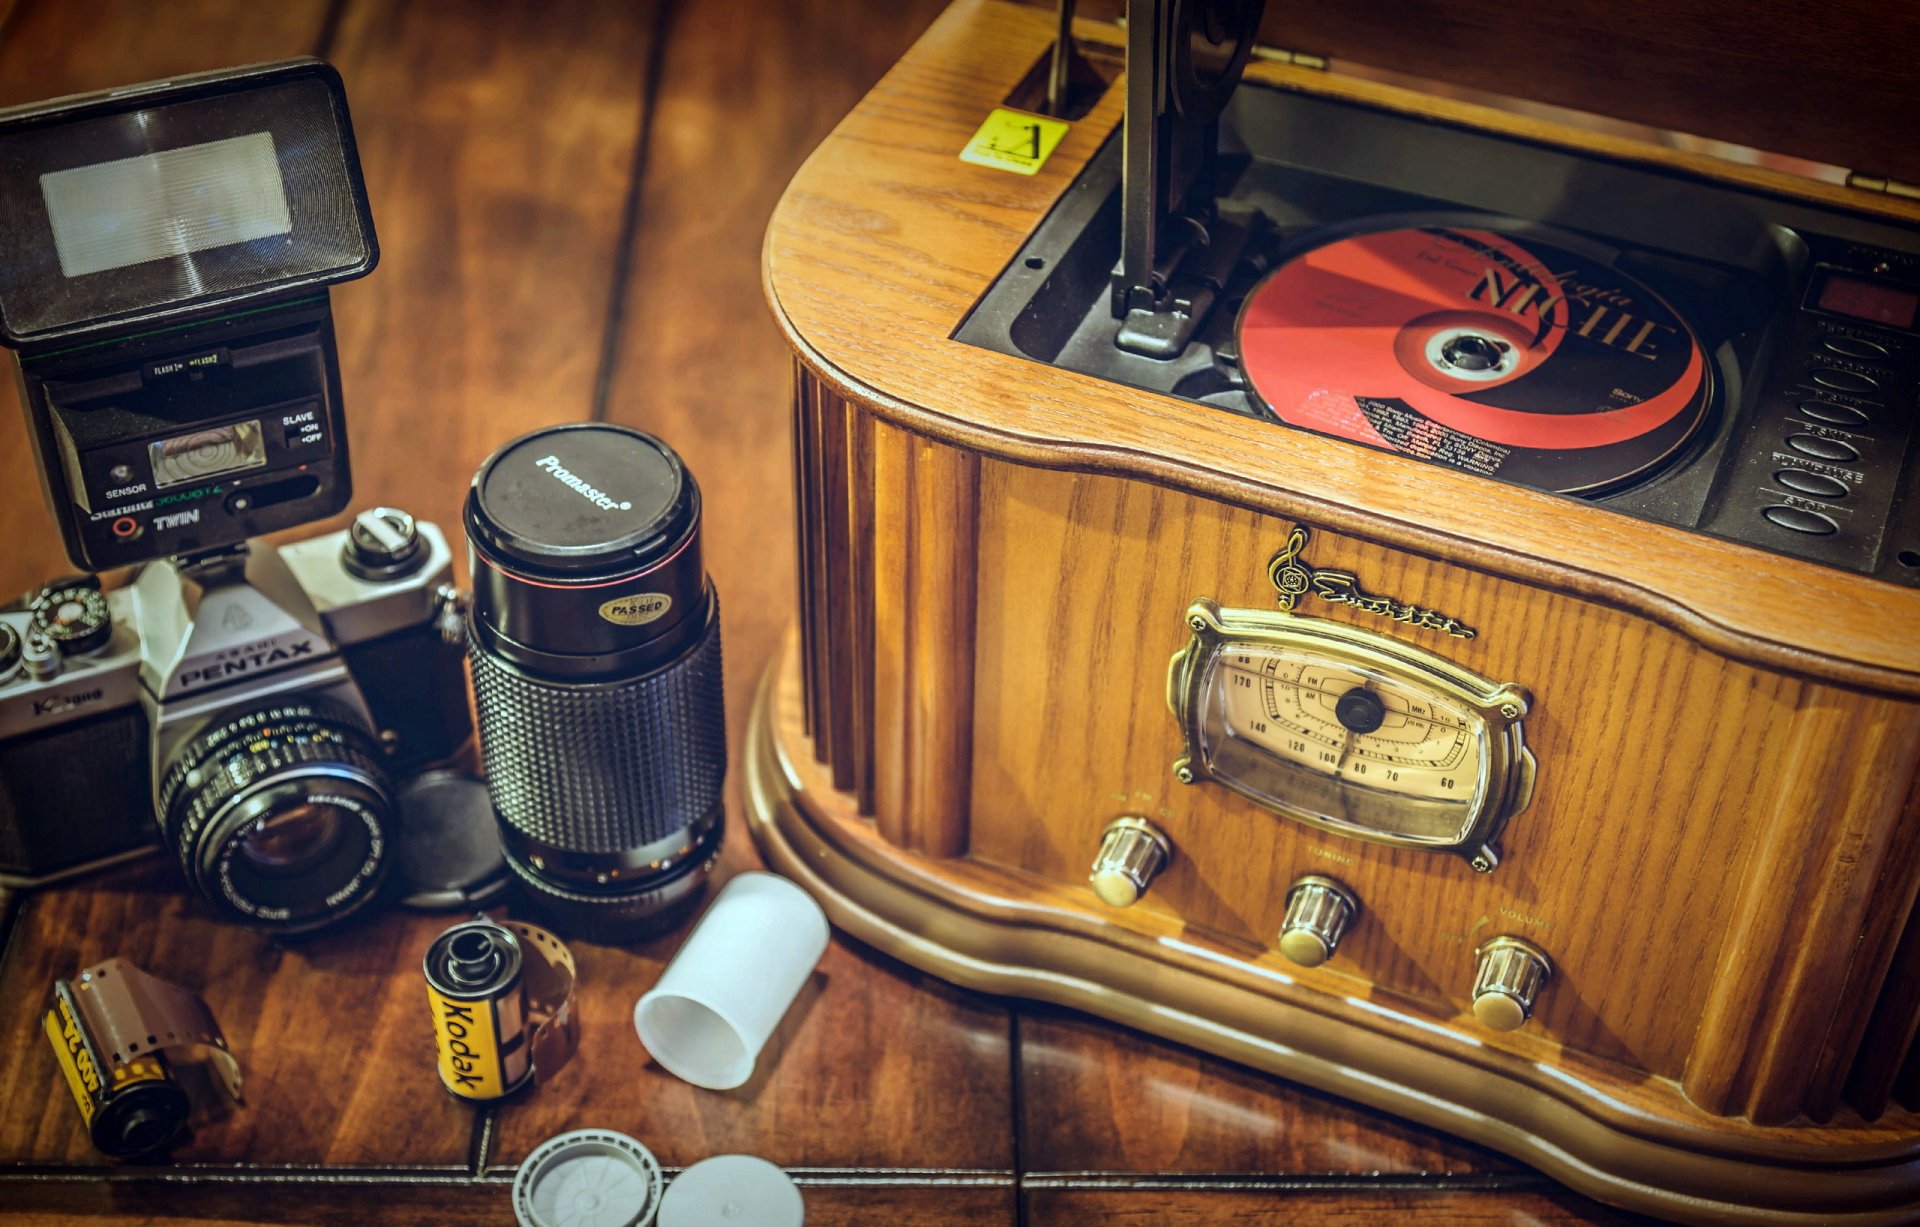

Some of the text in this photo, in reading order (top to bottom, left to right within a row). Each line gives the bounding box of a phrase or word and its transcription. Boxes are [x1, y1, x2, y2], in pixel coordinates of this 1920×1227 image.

[1466, 267, 1677, 361] NICHE
[283, 411, 314, 427] SLAVE
[304, 422, 319, 433] ON
[306, 432, 322, 444] OFF
[535, 455, 620, 511] Promaster
[106, 483, 147, 500] SENSOR
[153, 509, 200, 531] TWIN
[611, 601, 662, 615] PASSED
[180, 639, 313, 688] PENTAX
[1234, 674, 1251, 688] 170
[1307, 676, 1318, 686] FM
[1305, 692, 1316, 700] AM
[1411, 705, 1426, 715] MHz
[1250, 720, 1267, 734] 140
[1288, 739, 1306, 752] 120
[1319, 750, 1336, 764] 100
[1354, 762, 1367, 774] 80
[1386, 770, 1399, 782] 70
[1440, 777, 1454, 790] 60
[1500, 906, 1554, 930] VOLUME
[442, 1001, 484, 1092] Kodak
